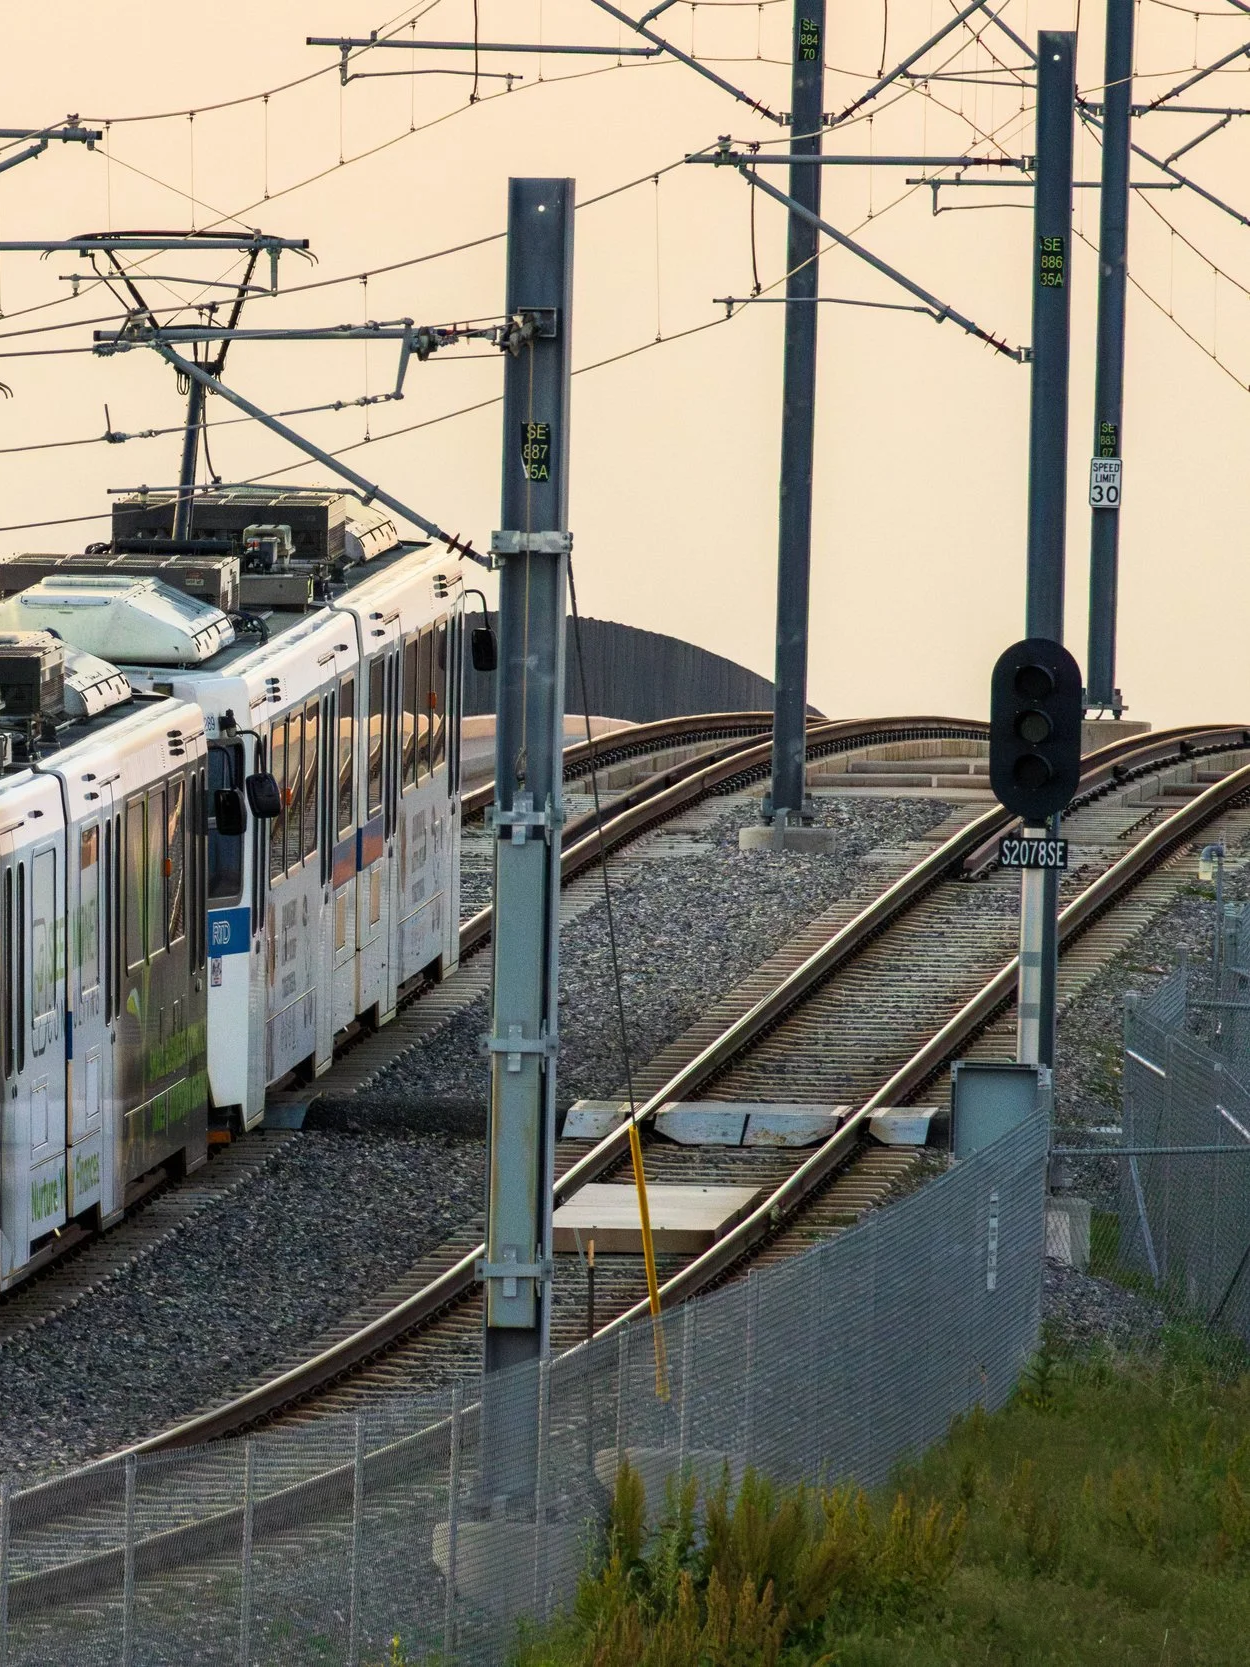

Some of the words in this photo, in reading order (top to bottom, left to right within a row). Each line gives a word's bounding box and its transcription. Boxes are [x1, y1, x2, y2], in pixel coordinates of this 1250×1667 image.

[802, 19, 817, 31] SE
[800, 34, 818, 45] 884
[803, 49, 815, 60] 70
[1043, 238, 1061, 251] SE
[1041, 255, 1063, 268] 886
[1040, 273, 1063, 286] 35A
[527, 424, 546, 439] SE
[1101, 422, 1115, 433] SE
[523, 444, 548, 459] 887
[1093, 462, 1120, 473] SPEED
[1095, 474, 1116, 484] LIMIT
[1091, 485, 1119, 503] 30
[1001, 840, 1065, 867] S2078SE
[212, 920, 230, 946] RTD
